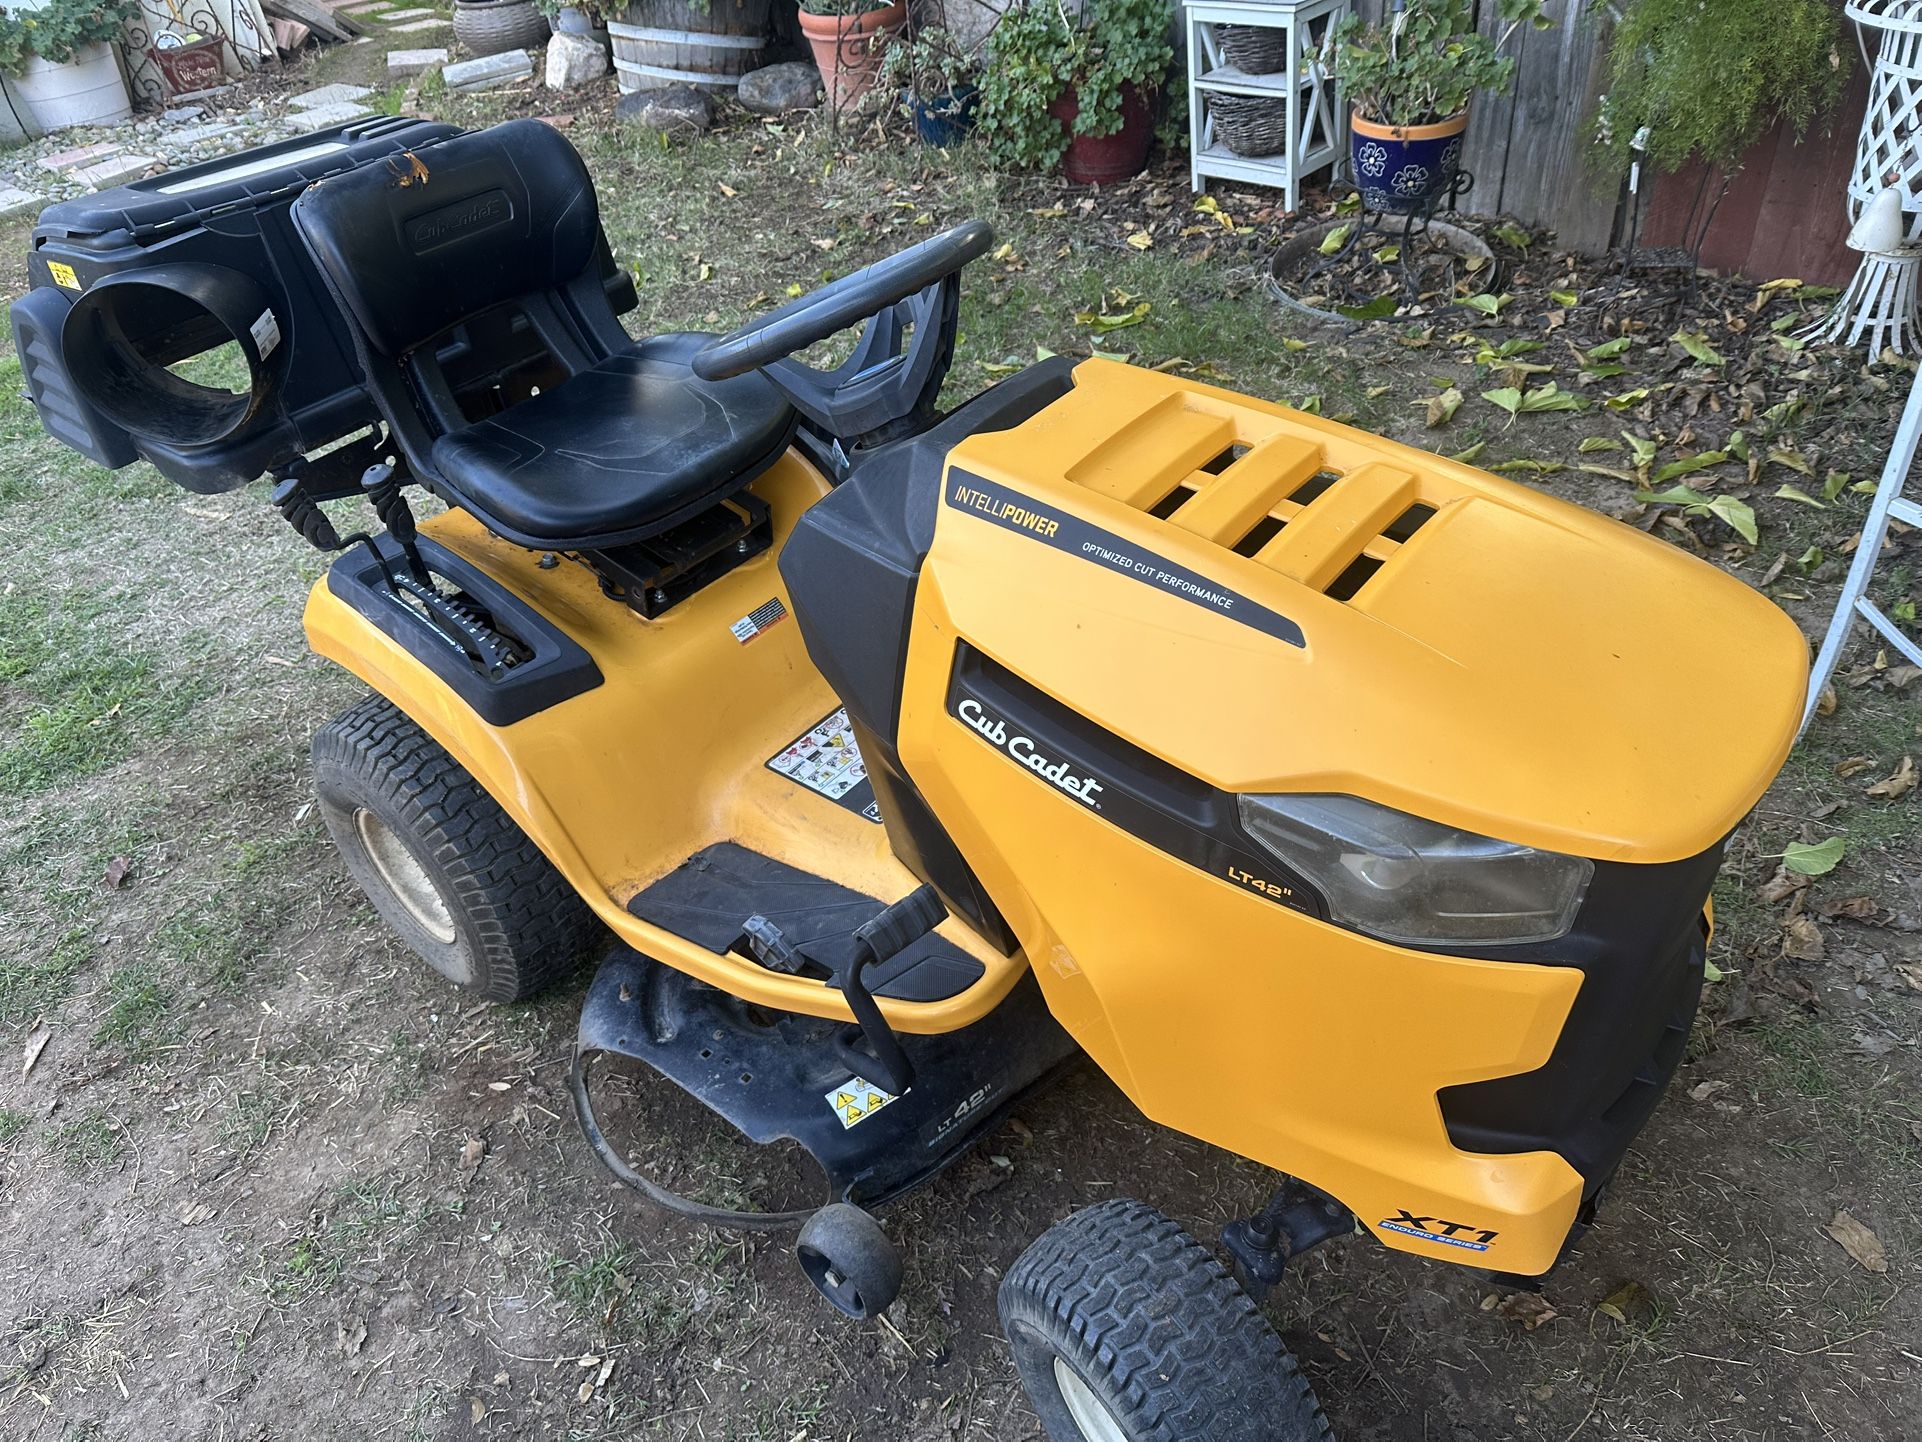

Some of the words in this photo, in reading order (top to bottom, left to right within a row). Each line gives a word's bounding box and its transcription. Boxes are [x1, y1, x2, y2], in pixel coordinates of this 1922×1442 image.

[954, 485, 1060, 538] INTELLIPOWER
[1082, 541, 1134, 569] OPTIMIZED
[1134, 562, 1157, 578] CUT
[1156, 571, 1234, 609] PERFORMANCE
[958, 699, 1007, 746] Cub
[1008, 736, 1103, 805] Cadet
[1228, 866, 1292, 898] LT42"
[937, 1117, 952, 1133] LT
[1381, 1221, 1433, 1239] ENDURO
[1384, 1208, 1499, 1244] XT1
